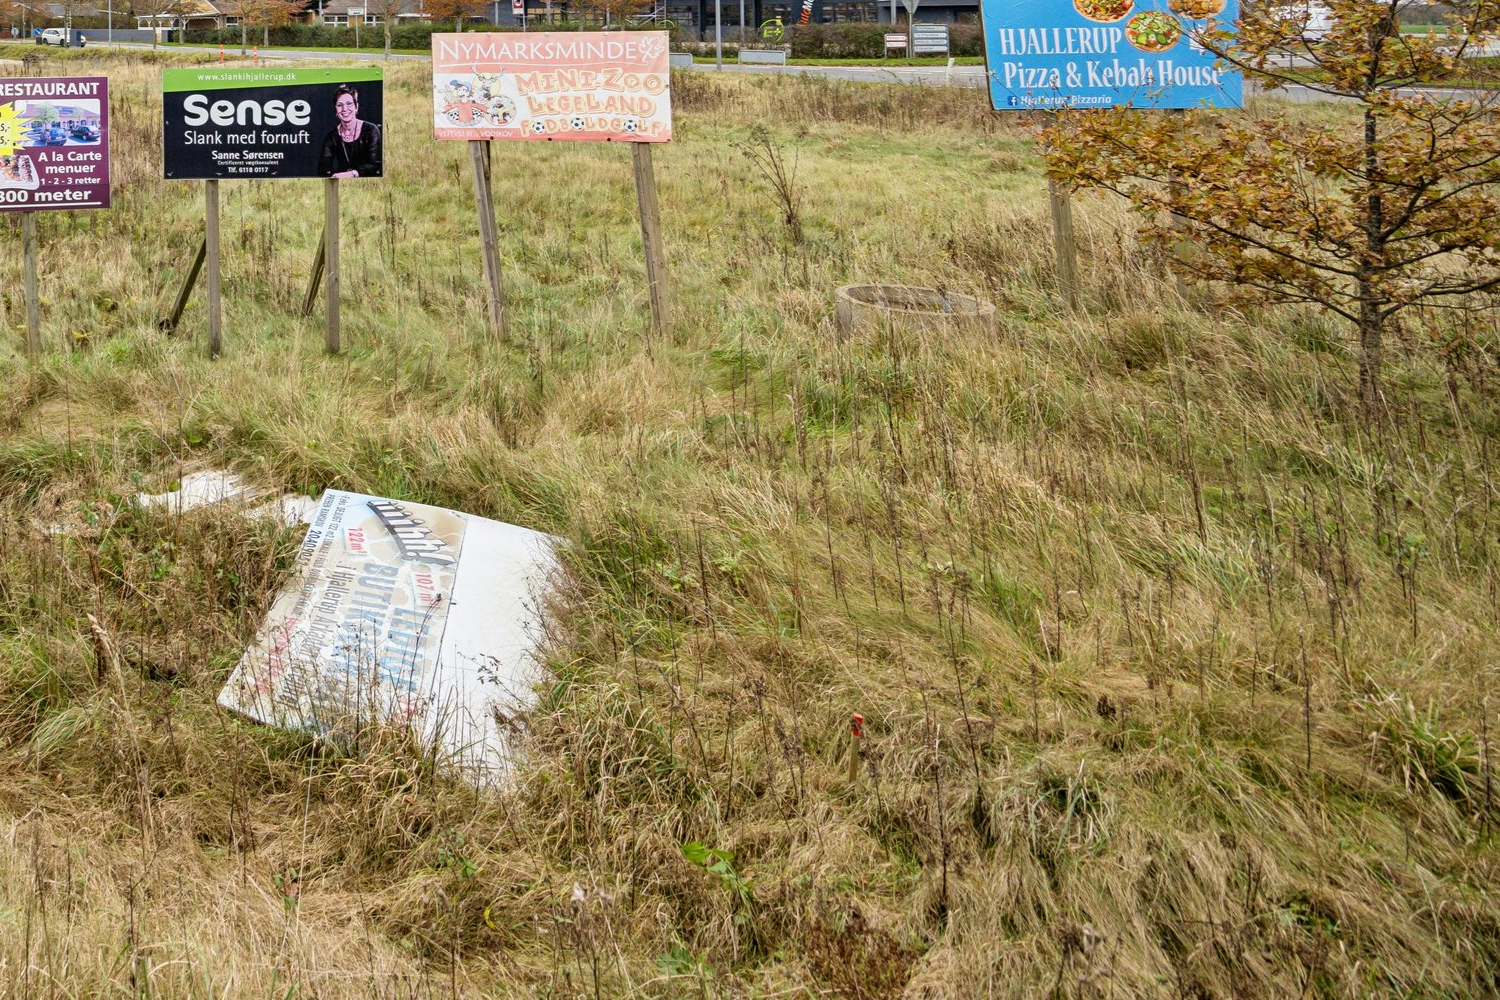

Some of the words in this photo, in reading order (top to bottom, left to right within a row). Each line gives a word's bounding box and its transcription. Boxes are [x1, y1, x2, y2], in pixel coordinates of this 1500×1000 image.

[999, 27, 1121, 55] HJALLERUP
[439, 40, 636, 60] NYMARKSMINDE
[198, 72, 296, 82] www.slankihjallerup.dk
[1004, 62, 1061, 88] Pizza
[1067, 62, 1082, 87] &
[1159, 60, 1223, 86] House
[528, 93, 655, 117] LEGELAND
[1071, 94, 1112, 104] Pizzaria
[183, 94, 311, 126] Sense
[184, 130, 222, 145] Slank
[227, 130, 256, 145] med
[261, 130, 310, 145] fornuft
[38, 152, 48, 162] A
[52, 152, 64, 161] la
[68, 151, 102, 161] Carte
[212, 151, 240, 159] Sanne
[243, 151, 284, 159] Sørensen
[45, 164, 95, 174] menuer
[35, 190, 91, 201] meter
[327, 522, 339, 530] 122
[348, 528, 363, 542] 122
[415, 574, 434, 590] 107
[312, 570, 354, 615] Hjallerup
